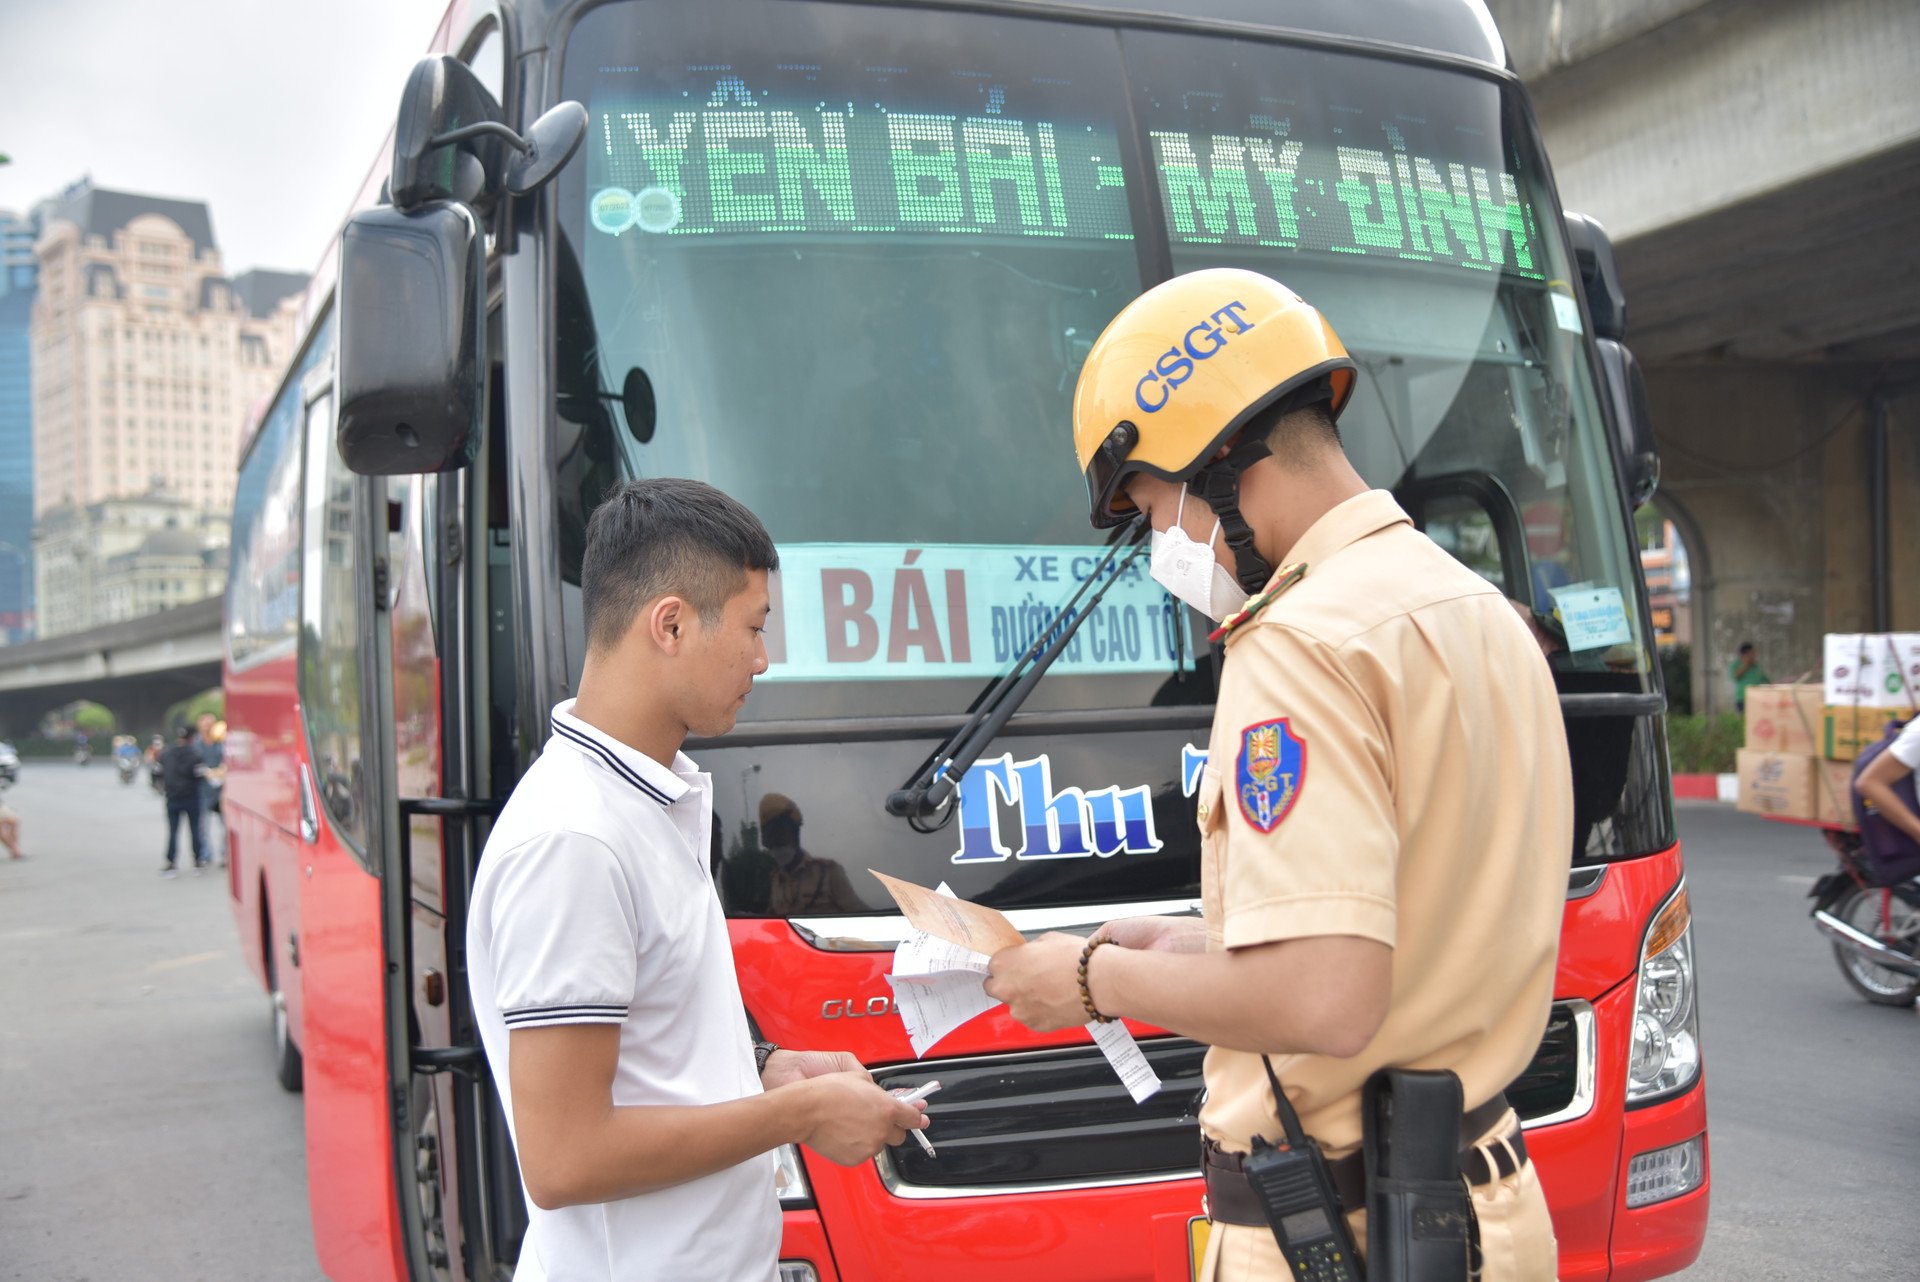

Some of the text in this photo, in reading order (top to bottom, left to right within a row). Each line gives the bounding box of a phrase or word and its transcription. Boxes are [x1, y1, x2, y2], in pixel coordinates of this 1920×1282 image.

[621, 77, 857, 222] YÊN
[887, 86, 1069, 227] BÁI
[1150, 113, 1303, 238] MỸ
[1335, 120, 1533, 269] ĐÌNH
[1135, 300, 1256, 414] CSGT
[819, 549, 972, 664] BÁI
[1013, 555, 1060, 582] XE
[1088, 603, 1142, 663] CAO
[934, 752, 1164, 865] Thu
[1241, 772, 1294, 800] CSGT
